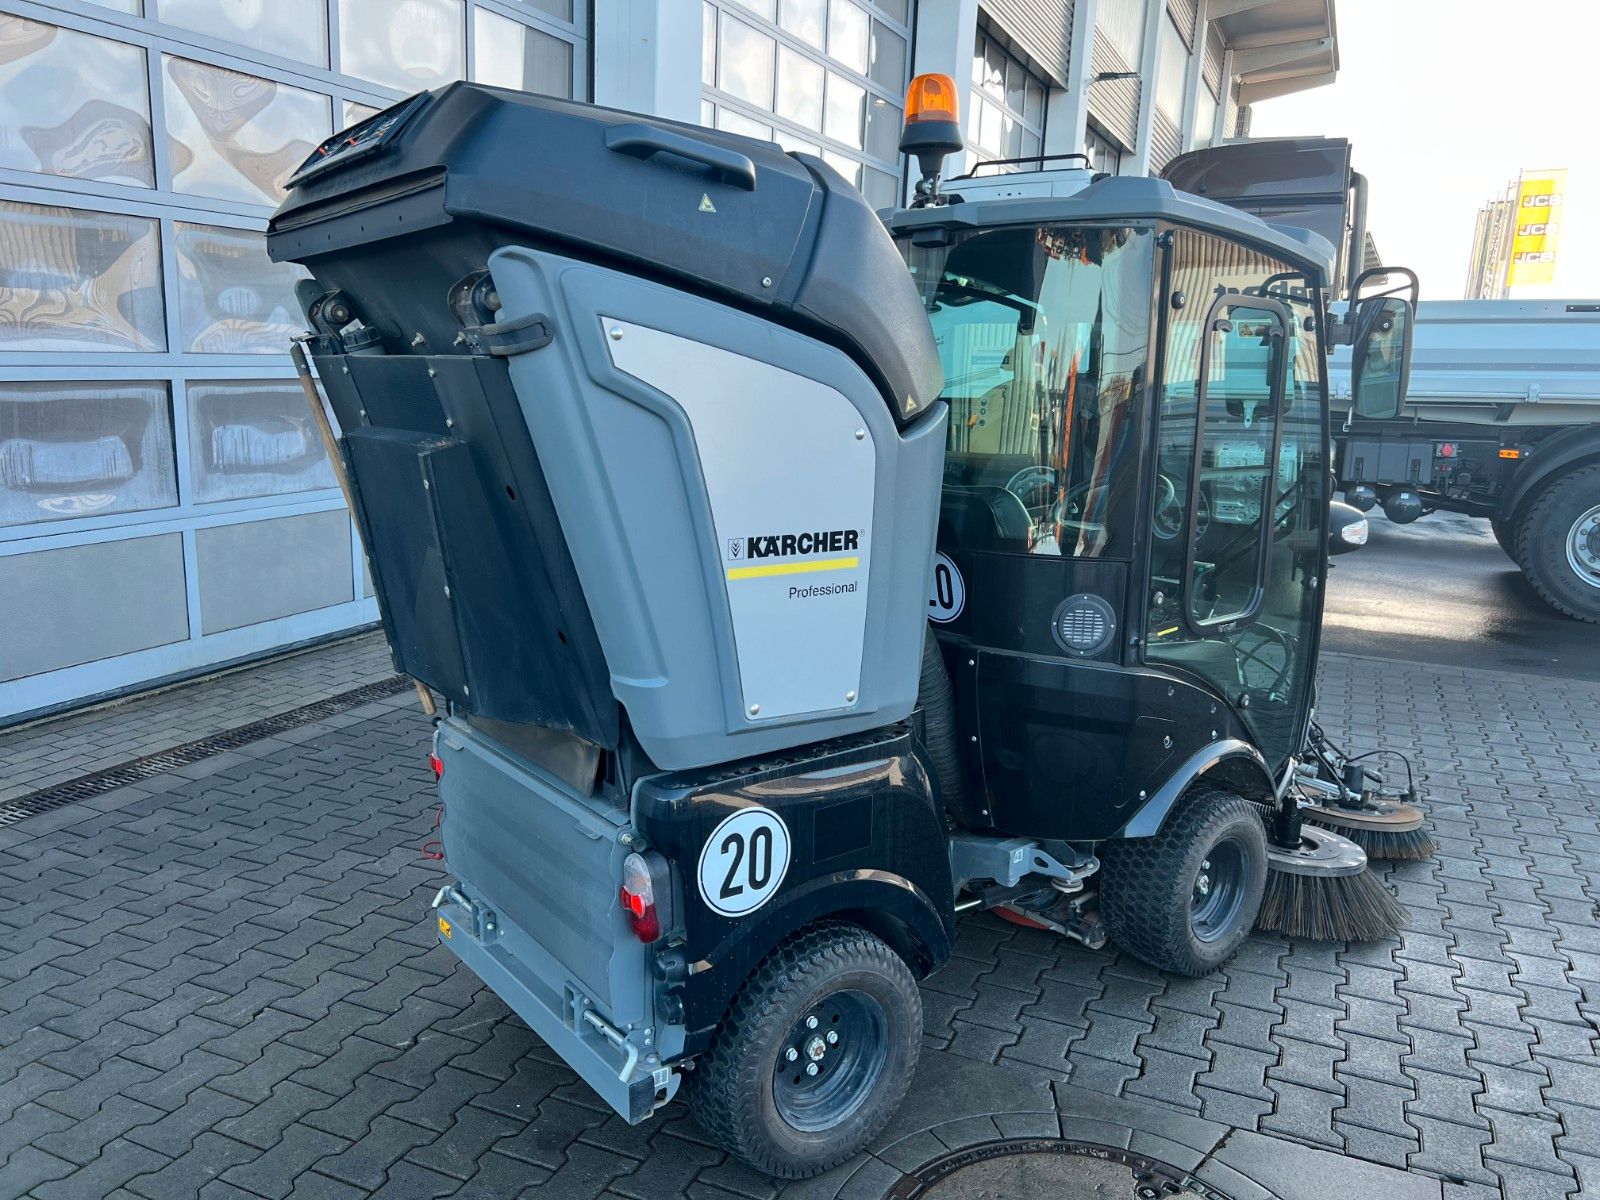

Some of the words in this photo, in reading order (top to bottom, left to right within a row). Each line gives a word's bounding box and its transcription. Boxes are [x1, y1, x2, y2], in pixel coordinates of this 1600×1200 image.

[1523, 194, 1563, 207] JCB
[1514, 252, 1555, 264] JCB
[748, 530, 859, 560] KÄRCHER
[789, 581, 858, 599] Professional
[929, 563, 954, 609] 0
[719, 826, 773, 899] 20
